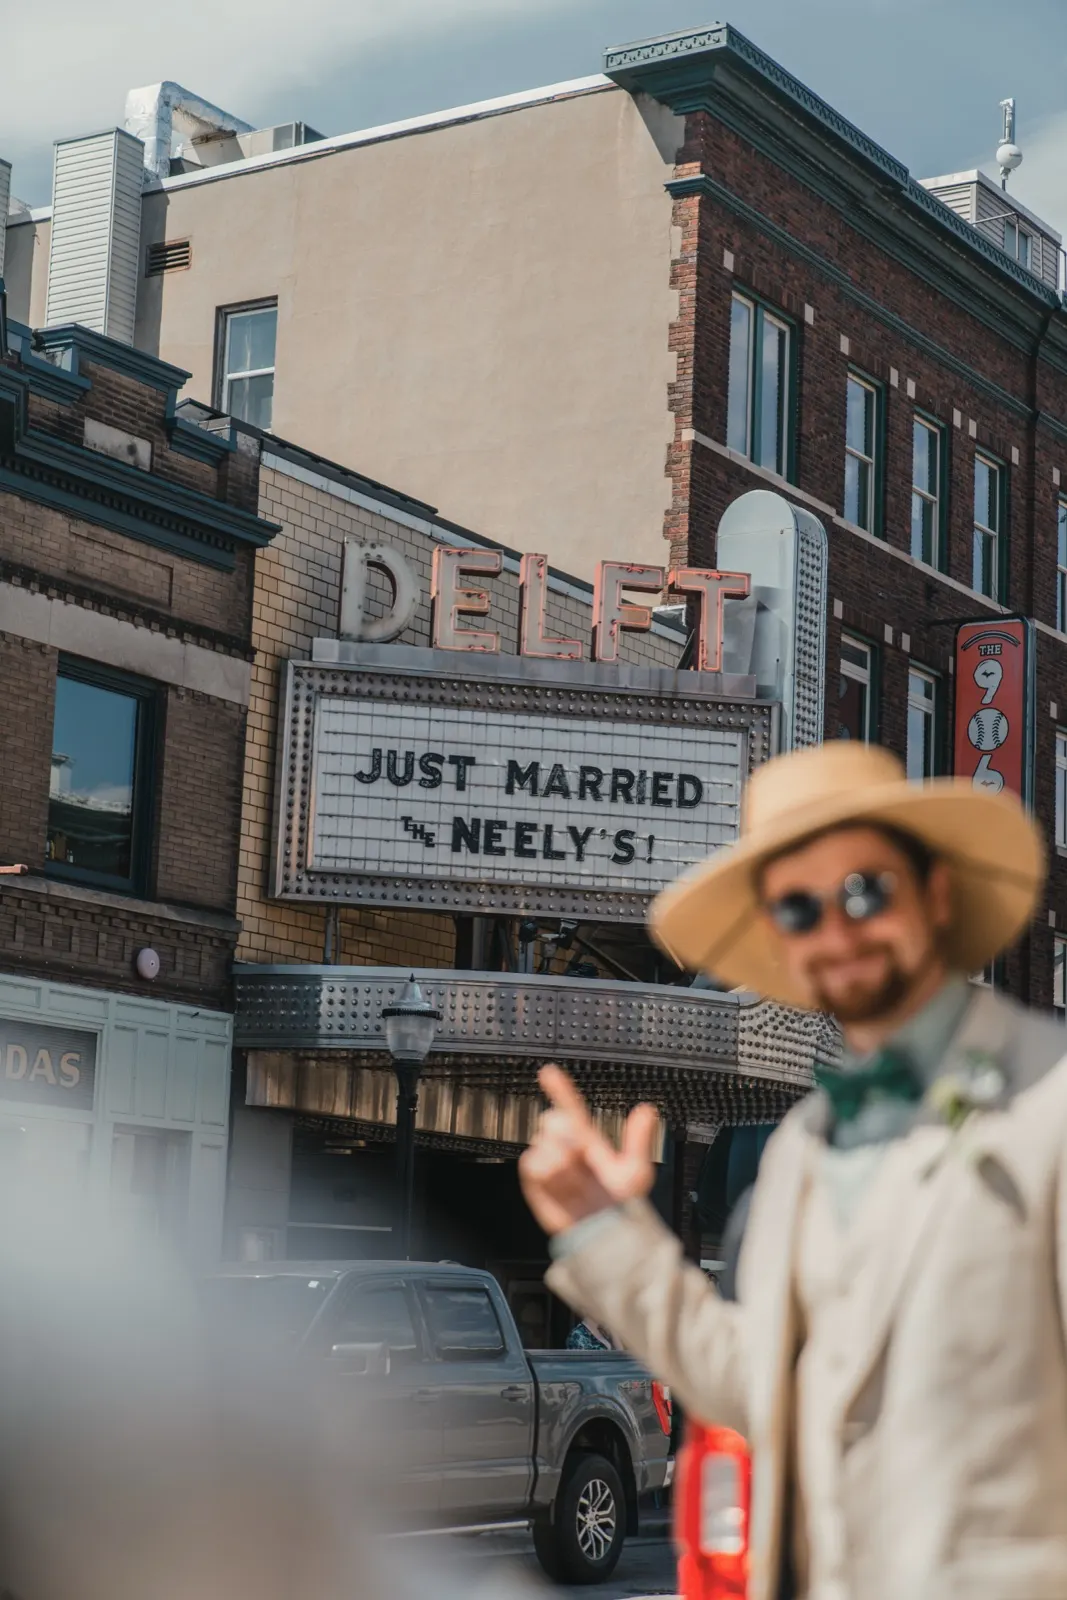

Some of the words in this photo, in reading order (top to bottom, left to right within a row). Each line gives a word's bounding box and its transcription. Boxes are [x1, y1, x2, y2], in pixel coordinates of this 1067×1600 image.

[338, 536, 752, 673] DELFT
[978, 643, 1002, 657] THE
[353, 747, 476, 792] JUST
[504, 759, 704, 809] MARRIED
[400, 816, 436, 848] THE
[451, 816, 655, 865] NEELY'S!
[0, 1044, 81, 1088] DAS
